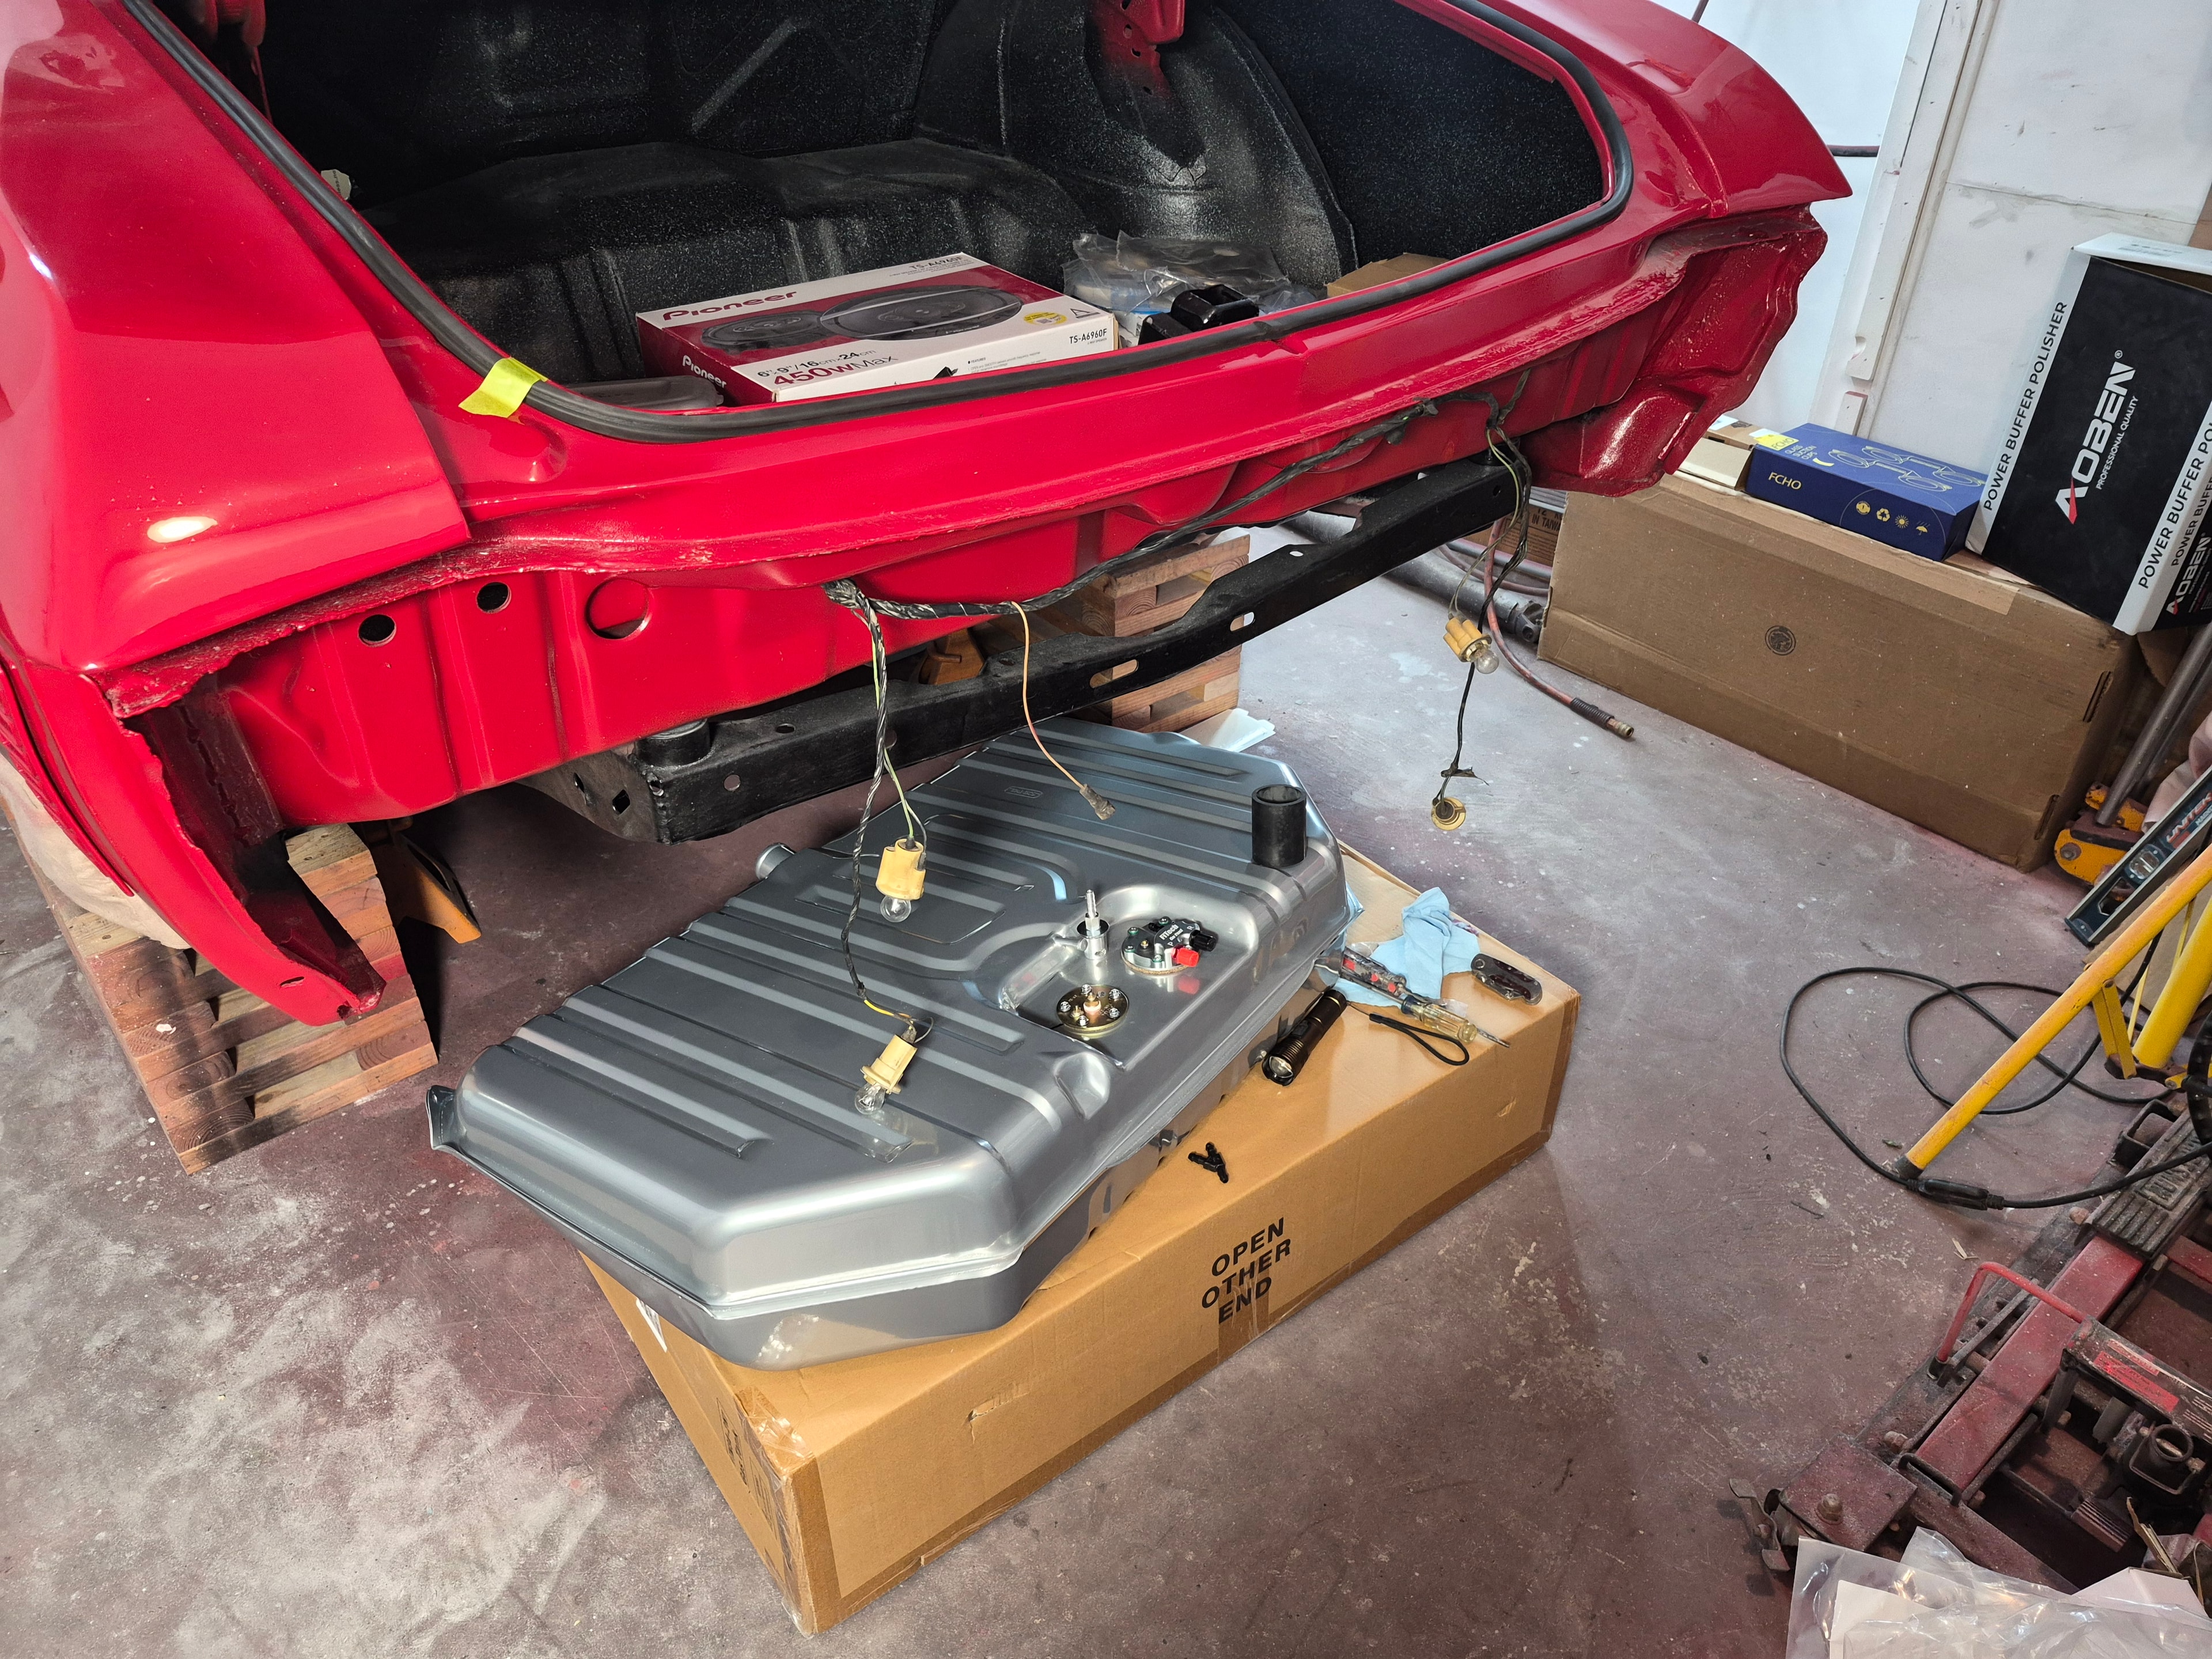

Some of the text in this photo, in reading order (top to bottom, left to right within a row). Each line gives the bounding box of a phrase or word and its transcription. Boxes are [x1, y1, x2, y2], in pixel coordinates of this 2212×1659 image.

[663, 291, 797, 321] Pioneer
[1069, 328, 1107, 344] TS-A6960F
[682, 355, 727, 389] Pioneer
[1983, 302, 2067, 510] POWER BUFFER POLISHER
[1771, 437, 1794, 449] FCHO
[2055, 361, 2136, 524] AOBEN
[2096, 395, 2139, 490] PROFESSIONAL QUALITY
[1768, 472, 1802, 490] FCHO
[2138, 527, 2173, 589] POWER
[2166, 457, 2205, 525] BUFFER
[2171, 520, 2198, 566] POWER
[1211, 1217, 1284, 1277] OPEN
[1202, 1238, 1291, 1309] OTHER
[1218, 1277, 1272, 1325] END
